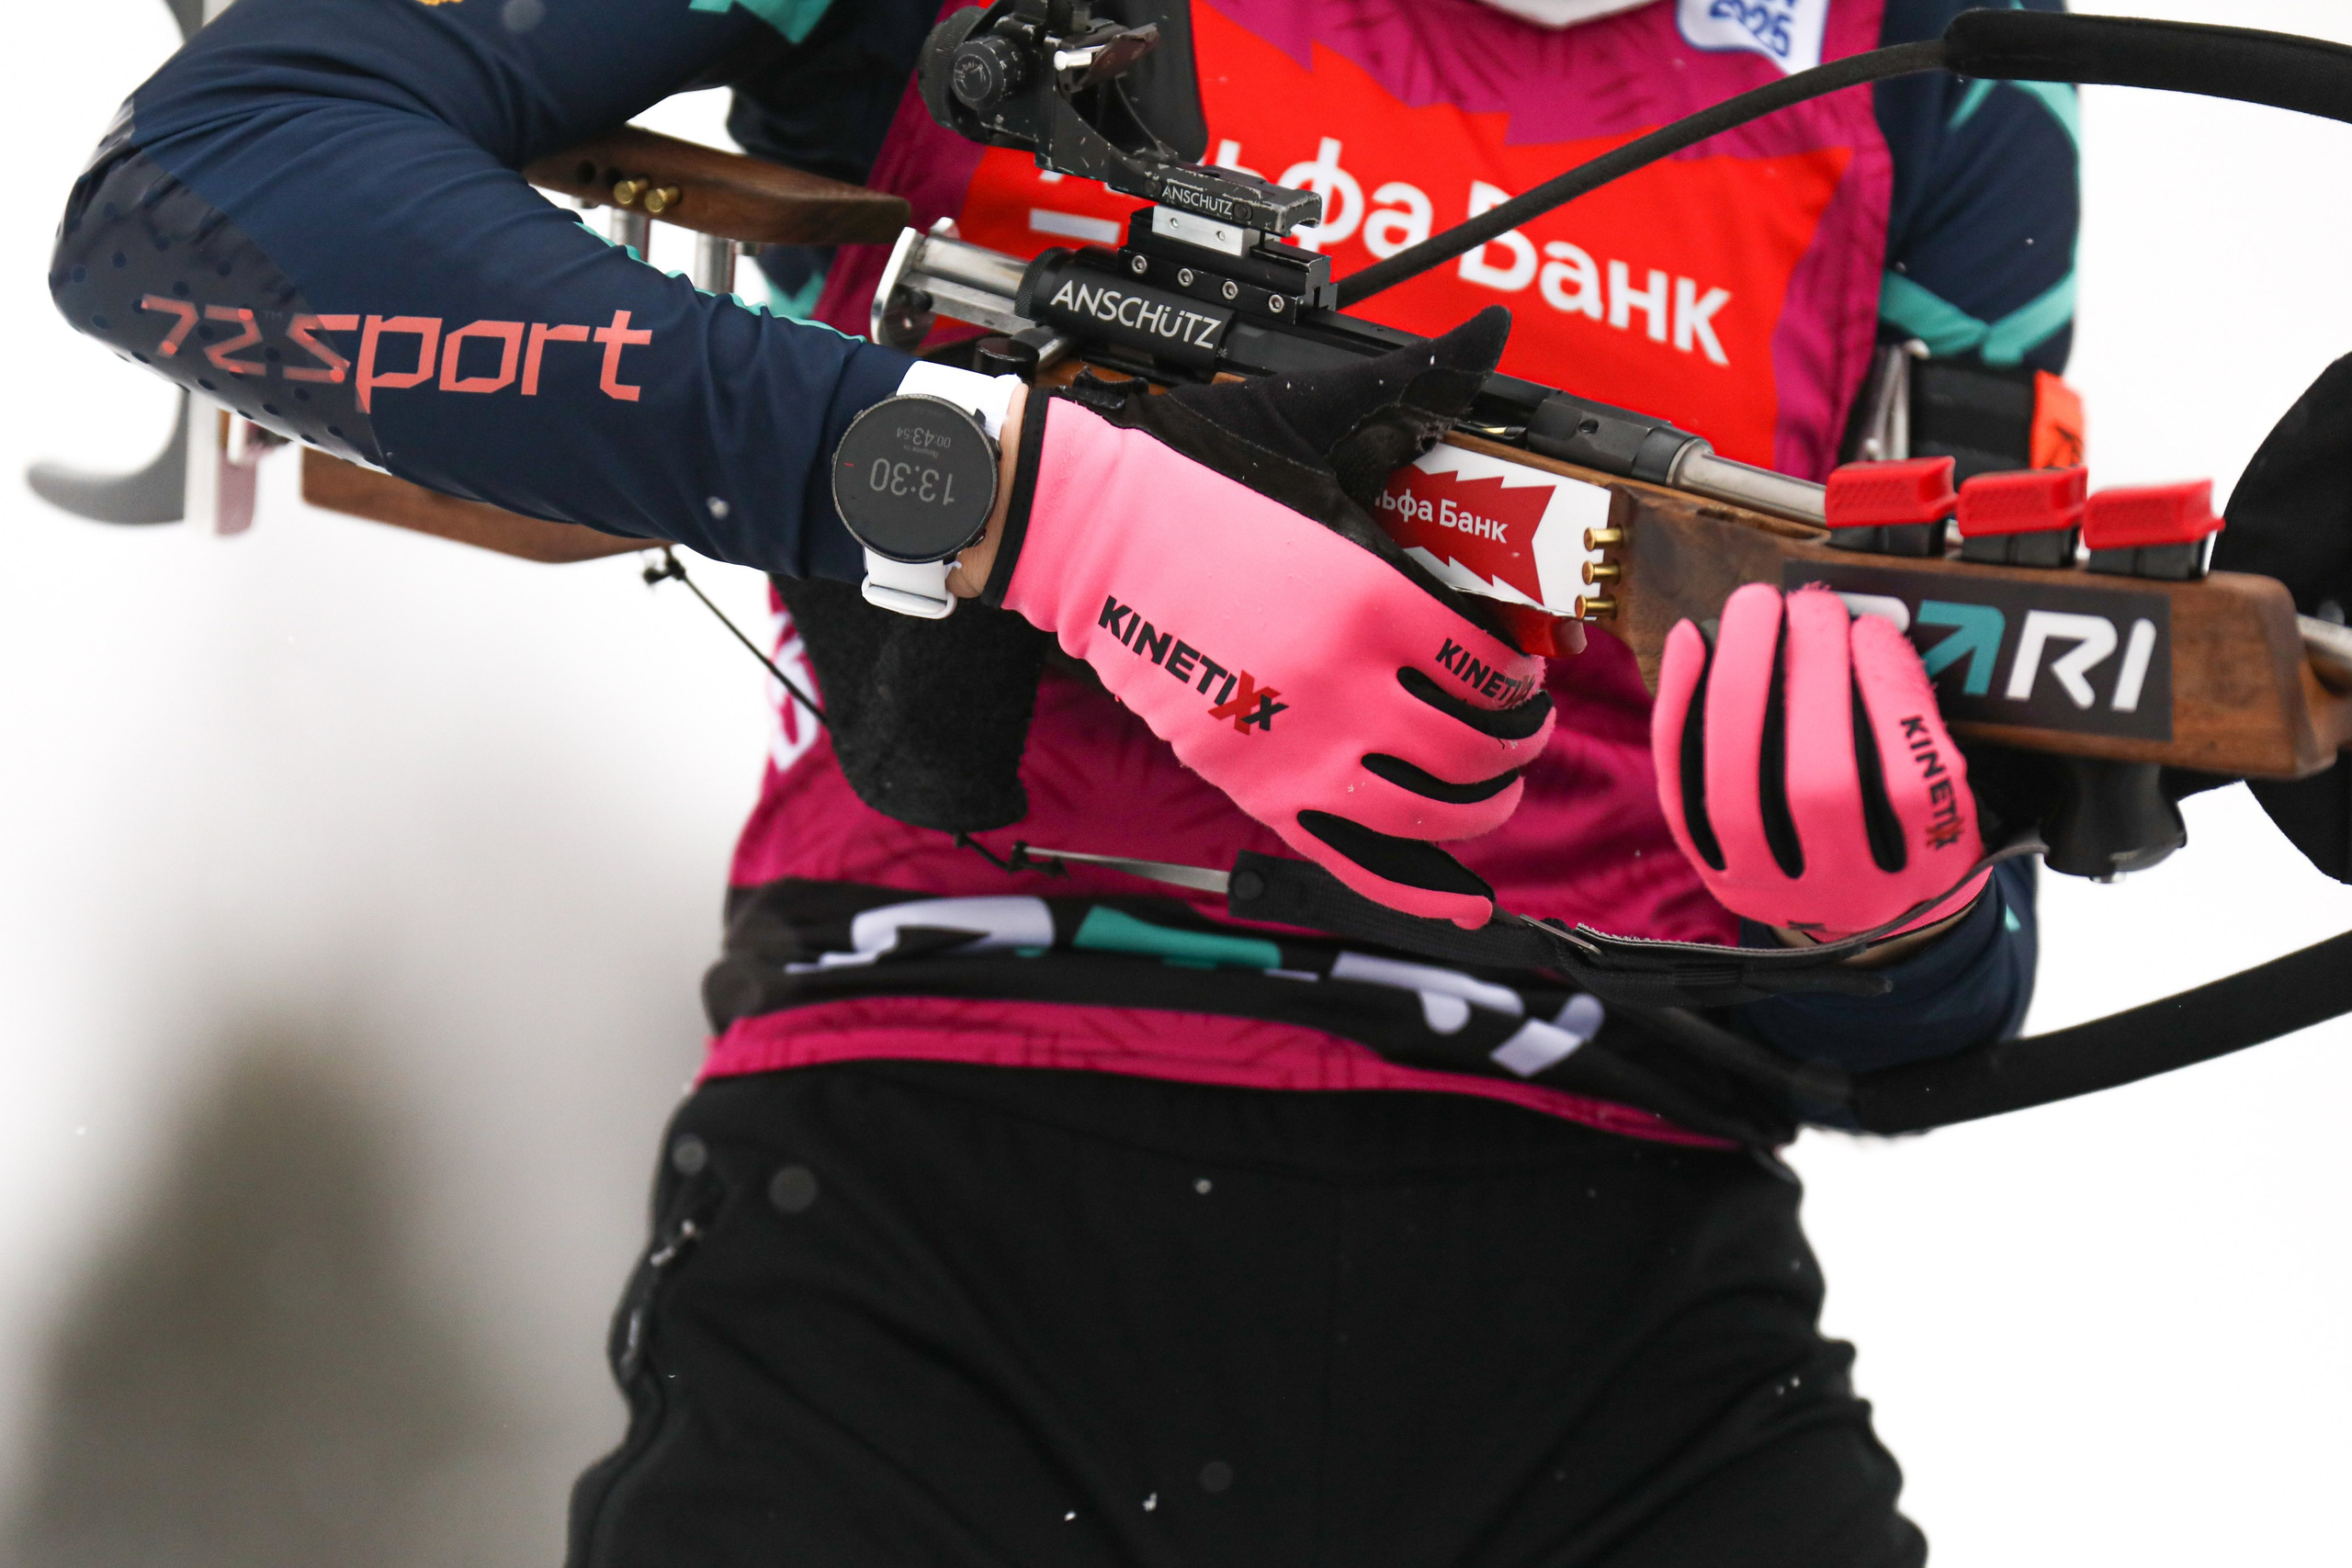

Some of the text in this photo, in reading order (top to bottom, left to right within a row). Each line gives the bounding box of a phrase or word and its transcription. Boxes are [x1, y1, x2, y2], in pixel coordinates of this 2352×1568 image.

[1457, 180, 1730, 366] Банк
[870, 457, 956, 506] 13:30
[1439, 498, 1509, 544] Банк
